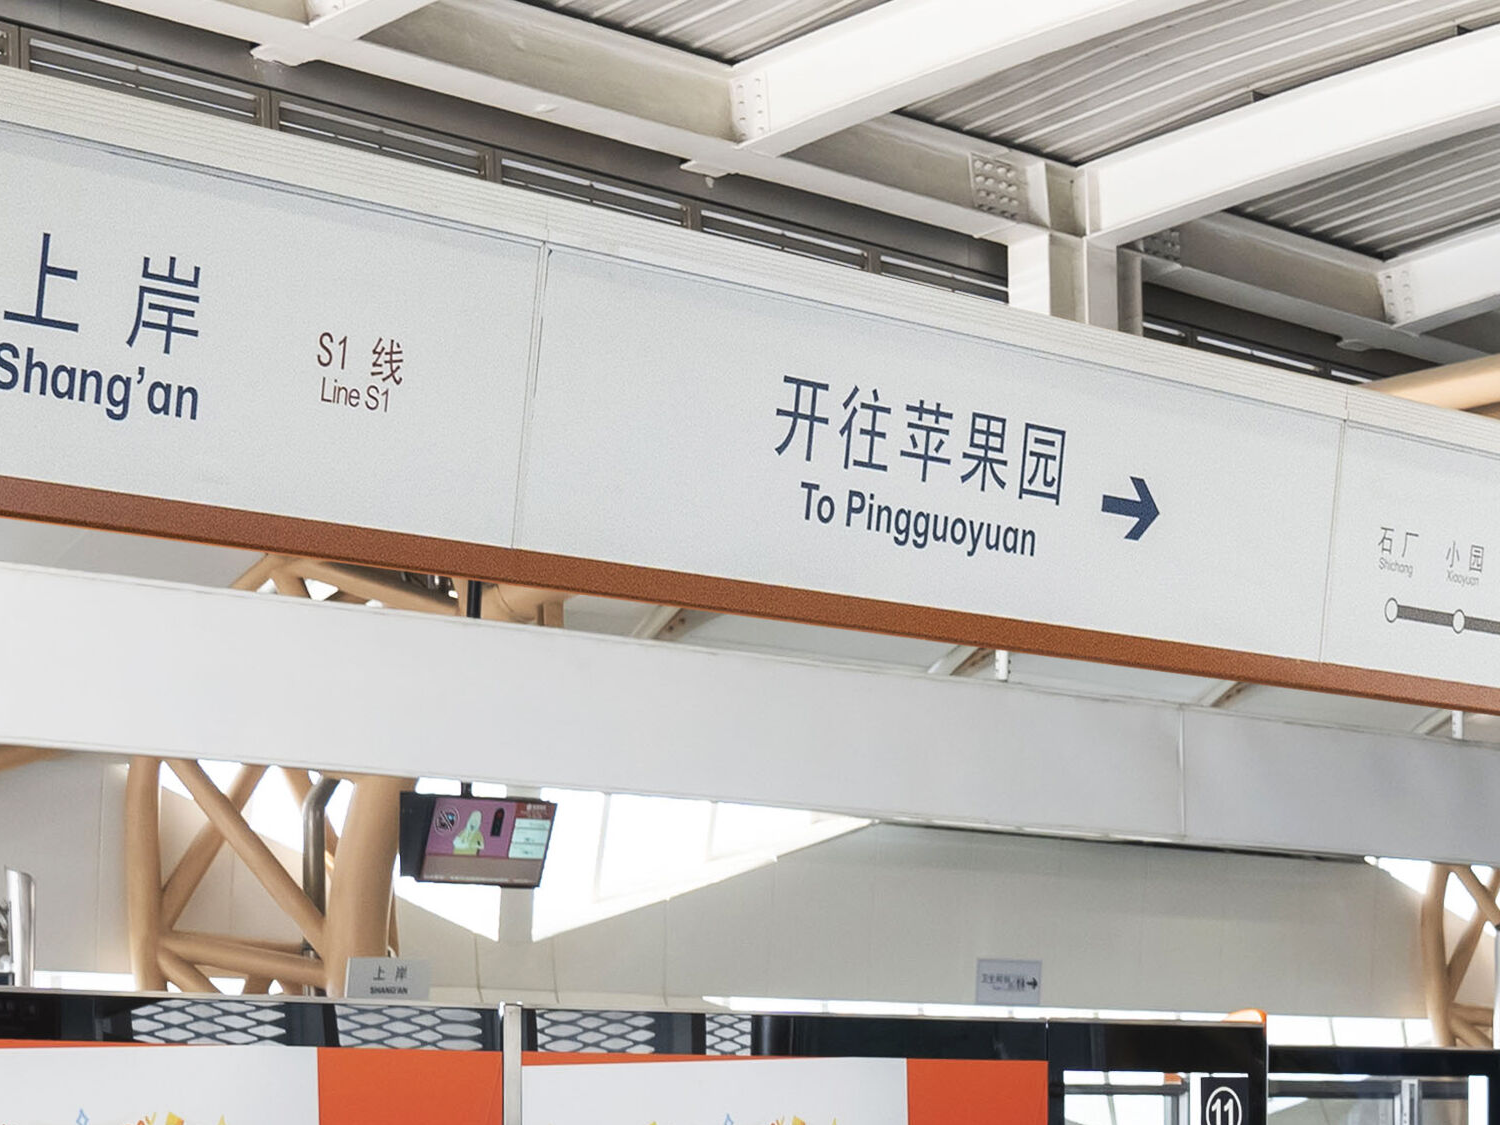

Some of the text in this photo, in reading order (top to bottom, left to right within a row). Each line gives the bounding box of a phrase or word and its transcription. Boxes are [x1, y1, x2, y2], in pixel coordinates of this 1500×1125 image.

[3, 232, 201, 356] 上岸
[320, 377, 392, 414] Line S1
[775, 375, 1067, 506] 开往苹果园
[800, 481, 1037, 557] To Pingguoyuan
[1378, 526, 1420, 558] 石厂
[1445, 540, 1485, 573] 小园
